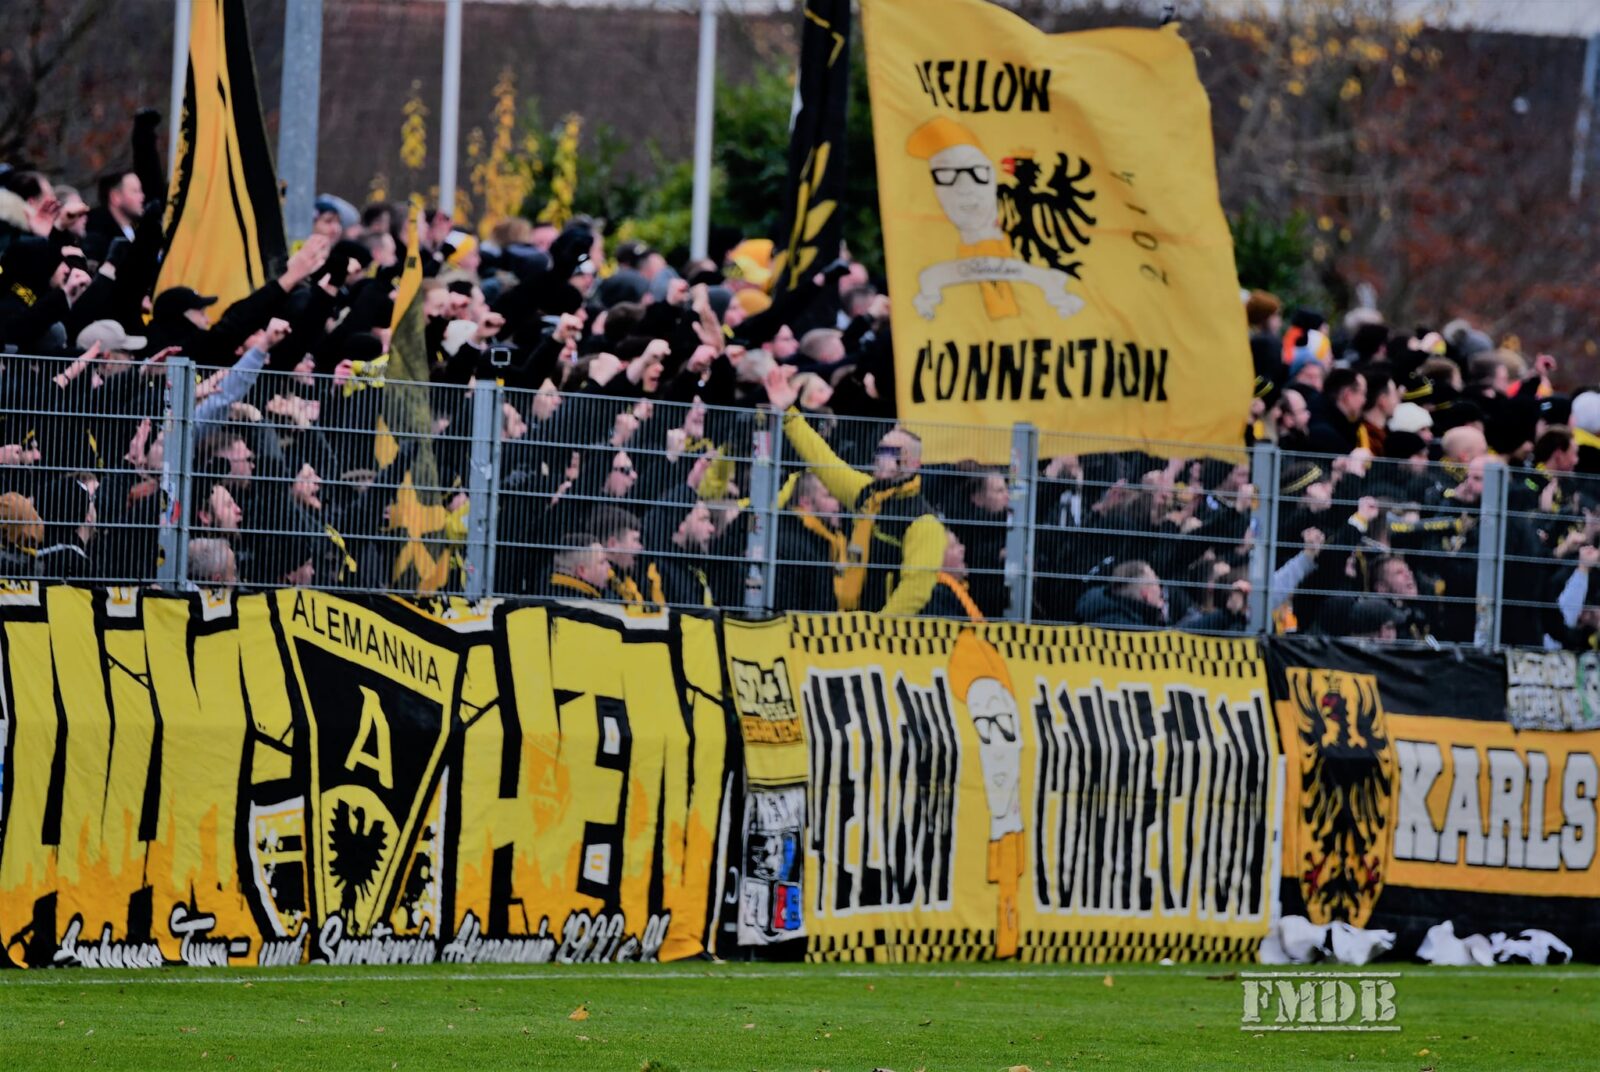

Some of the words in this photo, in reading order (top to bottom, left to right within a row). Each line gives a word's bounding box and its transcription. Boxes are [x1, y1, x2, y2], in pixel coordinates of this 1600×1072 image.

[914, 59, 1052, 113] YELLOW
[911, 338, 1169, 404] CONNECTION
[292, 589, 442, 692] ALEMANNIA
[1393, 739, 1598, 871] KARLS
